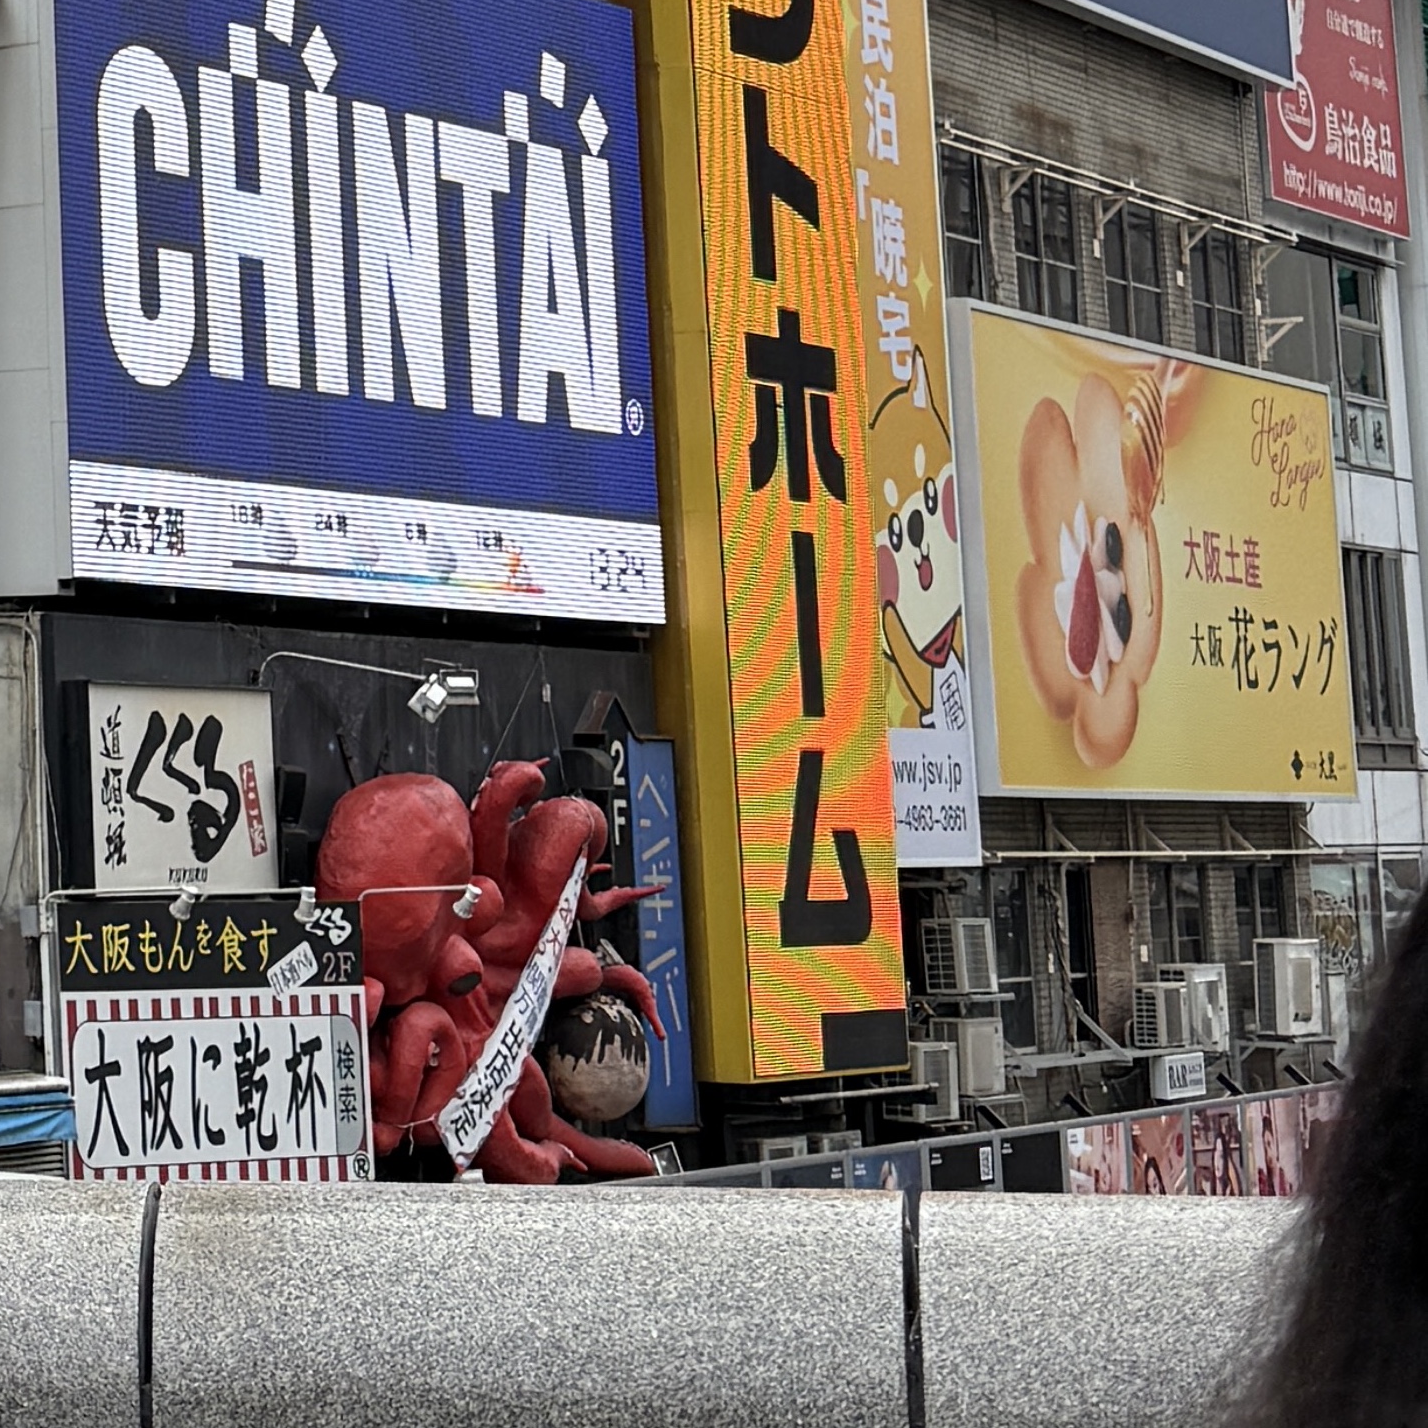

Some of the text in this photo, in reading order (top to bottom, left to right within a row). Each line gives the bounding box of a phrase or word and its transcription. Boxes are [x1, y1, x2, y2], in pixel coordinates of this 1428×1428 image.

[94, 501, 185, 557] 天気予報
[1183, 525, 1263, 590] 大阪土産
[100, 704, 128, 871] 道頓堀
[126, 710, 242, 864] くくる
[610, 738, 628, 847] 2F
[892, 754, 962, 794] ww.jsv.jp
[895, 804, 967, 833] -4963-3661
[64, 915, 278, 974] 大阪もんを食す
[322, 951, 356, 983] 2F
[84, 1021, 328, 1159] 大阪に乾杯
[336, 1040, 358, 1124] 検索
